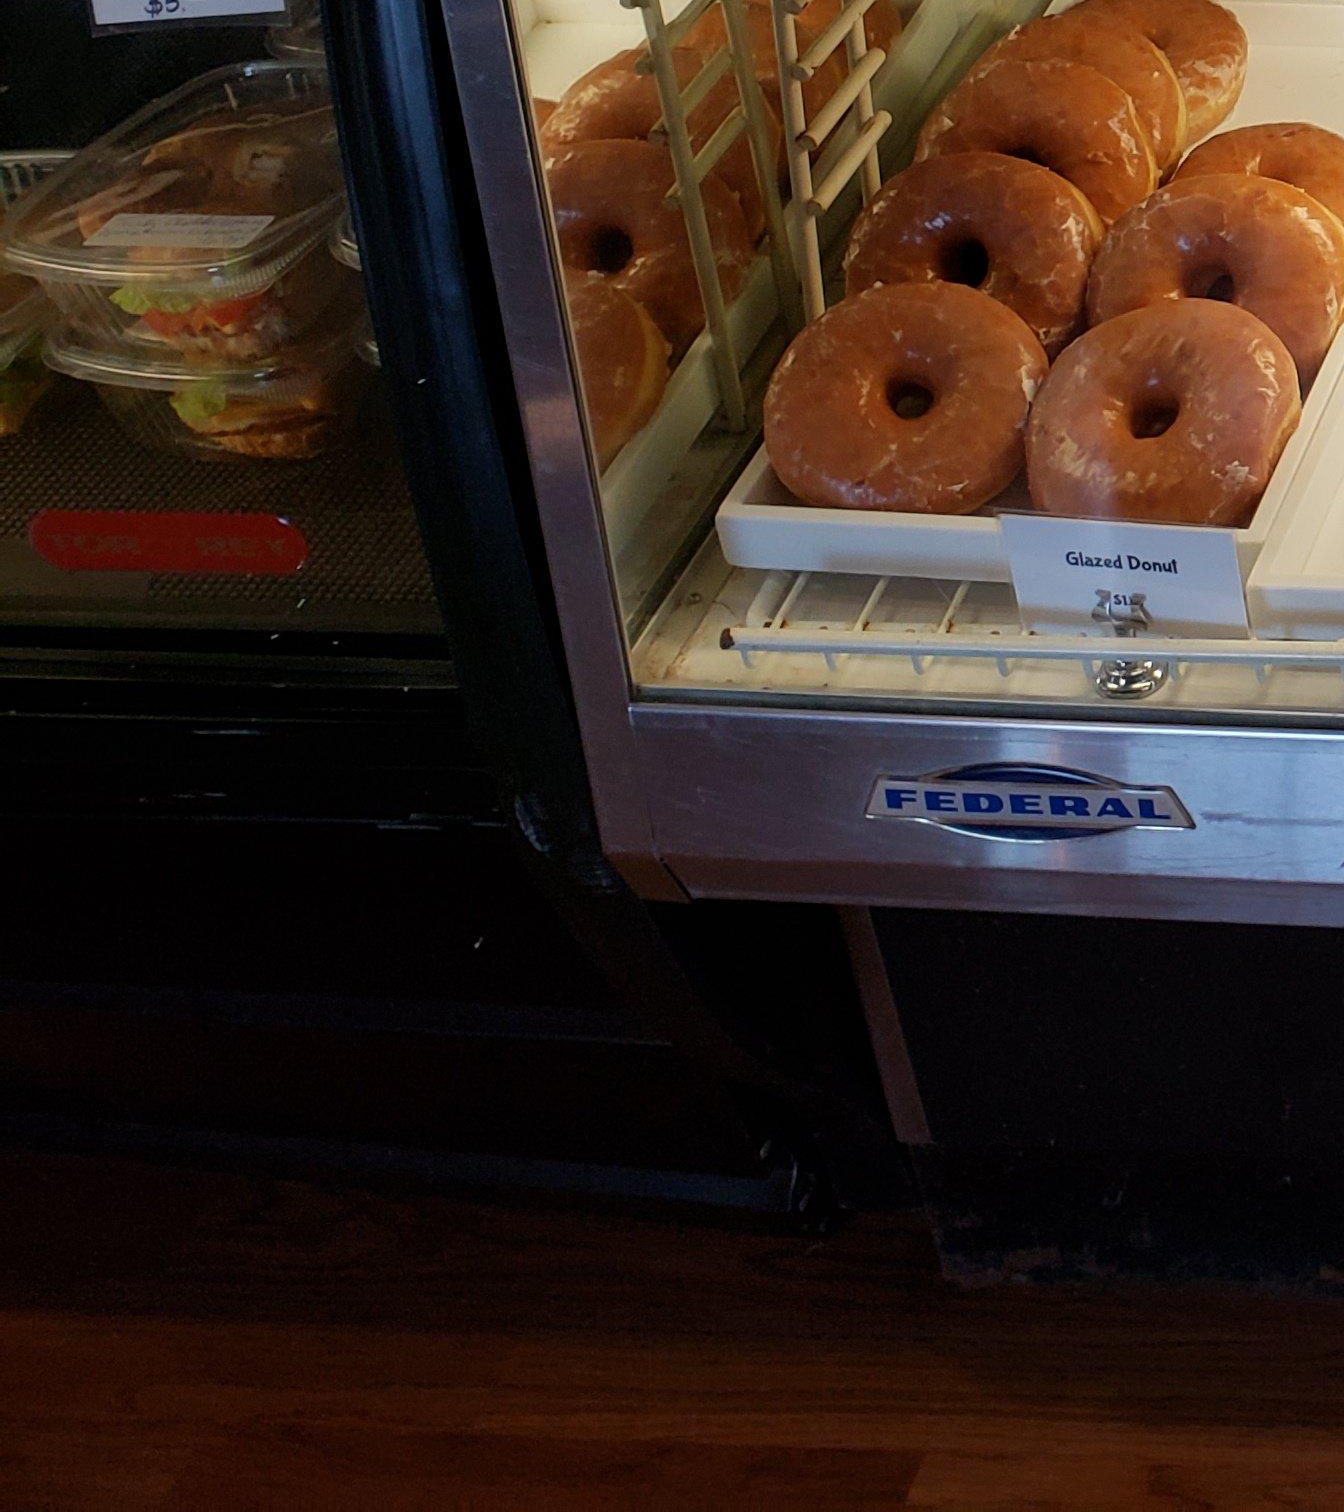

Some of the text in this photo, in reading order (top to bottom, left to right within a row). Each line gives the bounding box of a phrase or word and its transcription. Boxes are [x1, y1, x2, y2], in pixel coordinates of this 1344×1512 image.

[1065, 550, 1179, 575] Glazed Donut
[884, 788, 1172, 820] FEDERAL
